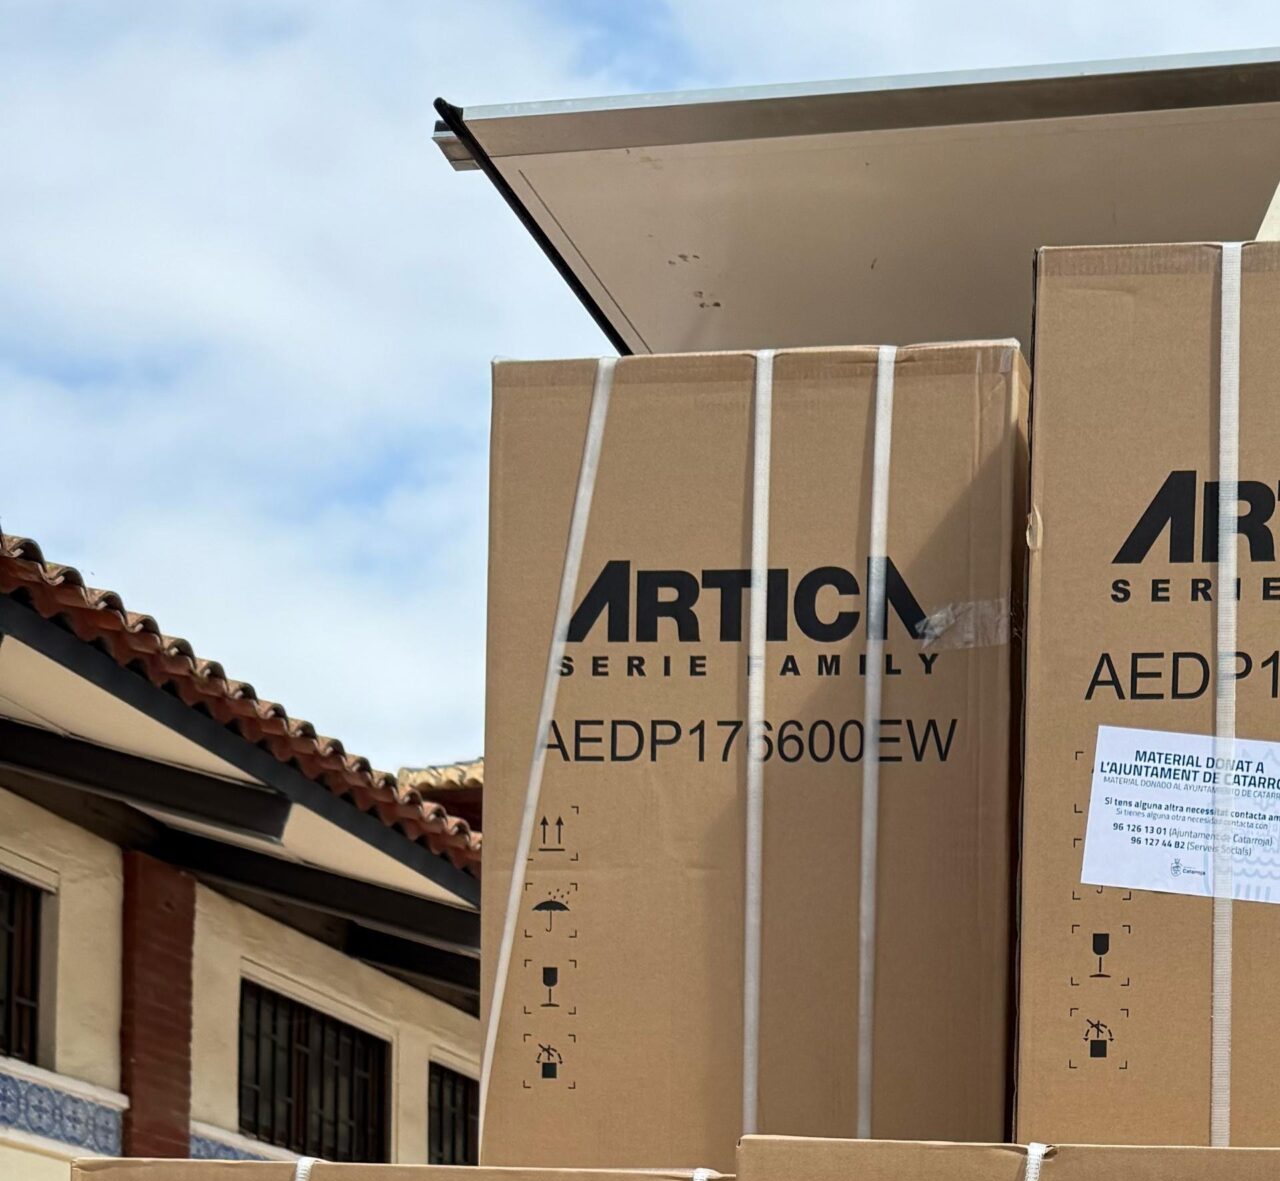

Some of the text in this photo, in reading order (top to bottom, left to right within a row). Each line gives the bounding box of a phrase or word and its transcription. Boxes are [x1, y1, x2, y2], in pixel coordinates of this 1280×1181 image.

[563, 556, 934, 643] ARTICA
[558, 653, 939, 677] SERIE AMILY
[1135, 750, 1202, 768] MATERIAL
[1255, 762, 1264, 773] A
[1203, 772, 1219, 784] DE
